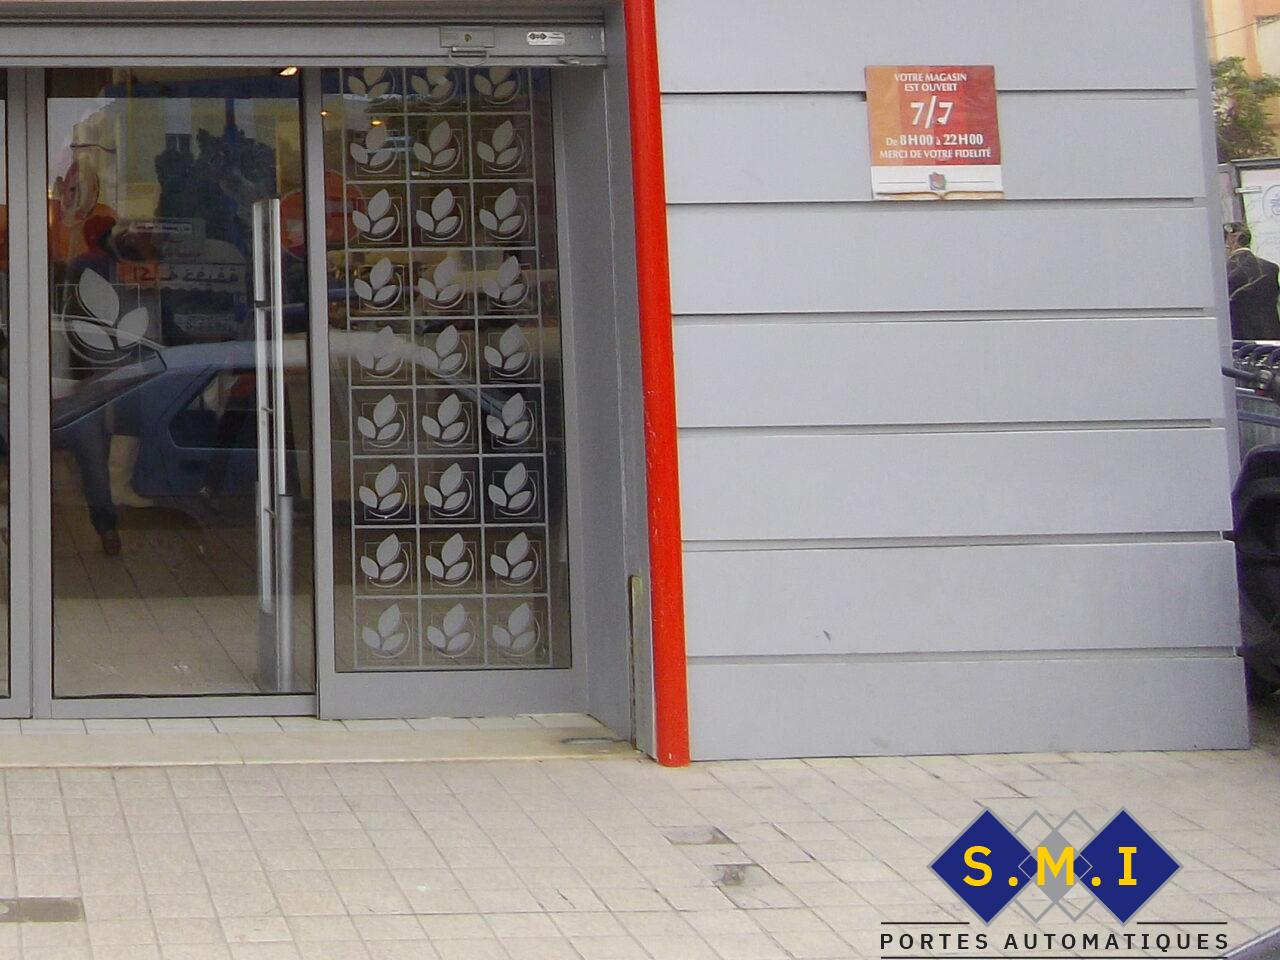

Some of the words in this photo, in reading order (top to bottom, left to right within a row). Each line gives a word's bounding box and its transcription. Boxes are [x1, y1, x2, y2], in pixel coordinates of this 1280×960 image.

[894, 72, 924, 82] VOTRE
[924, 72, 968, 82] MAGASIN
[904, 83, 920, 91] EST
[921, 82, 958, 91] OUVERT
[910, 95, 953, 128] 7/7
[942, 133, 984, 145] 22H00
[880, 149, 908, 159] MERCI
[910, 149, 923, 158] DE
[925, 148, 953, 158] VOTRE
